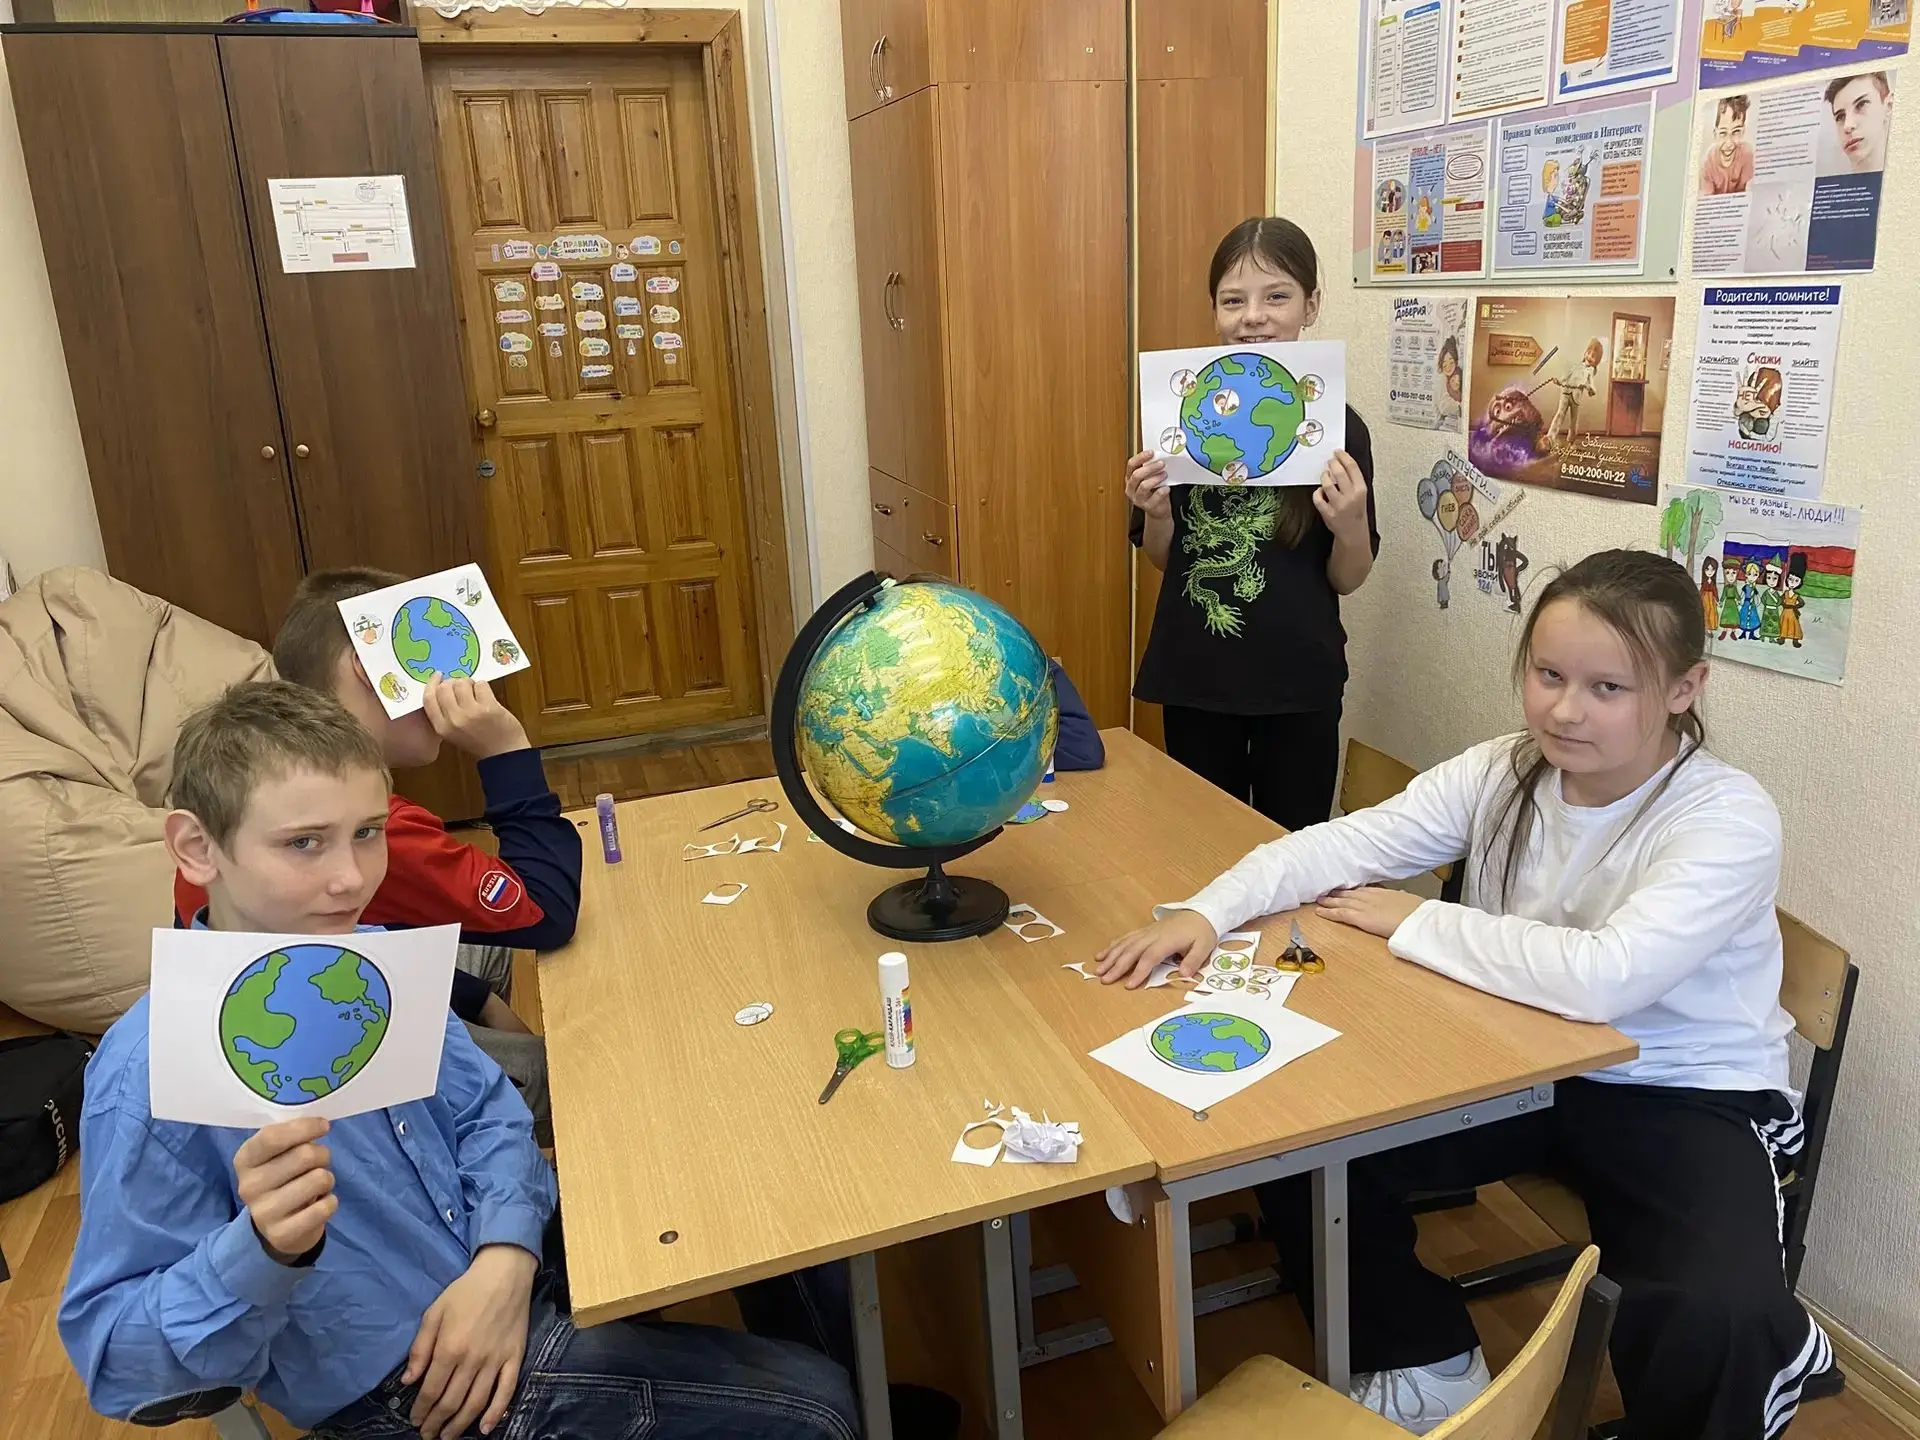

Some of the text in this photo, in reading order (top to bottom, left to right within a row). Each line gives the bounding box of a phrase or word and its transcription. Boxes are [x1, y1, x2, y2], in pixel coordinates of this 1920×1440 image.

[1503, 121, 1576, 141] Правила безопасного
[1555, 131, 1591, 144] поведения
[1601, 124, 1642, 138] Интернете
[563, 240, 599, 248] ПРАВИЛА
[1716, 288, 1830, 303] Родители, помните!
[1394, 298, 1418, 309] Школа
[1747, 352, 1782, 365] Скажи
[1738, 390, 1757, 401] НЕТ
[1728, 440, 1782, 454] насилию!
[1726, 461, 1745, 470] Всегда
[1447, 450, 1496, 499] ОТПУСТИ...
[1561, 463, 1626, 482] 8-800-200-01-22
[1716, 478, 1746, 489] Откажись
[1742, 496, 1755, 506] ВСЕ
[1441, 503, 1455, 513] ГНЕВ
[1750, 507, 1759, 515] НО
[1762, 509, 1775, 517] ВСЕ
[1474, 568, 1498, 582] ЗВОНИ
[481, 874, 499, 898] RUSSIA
